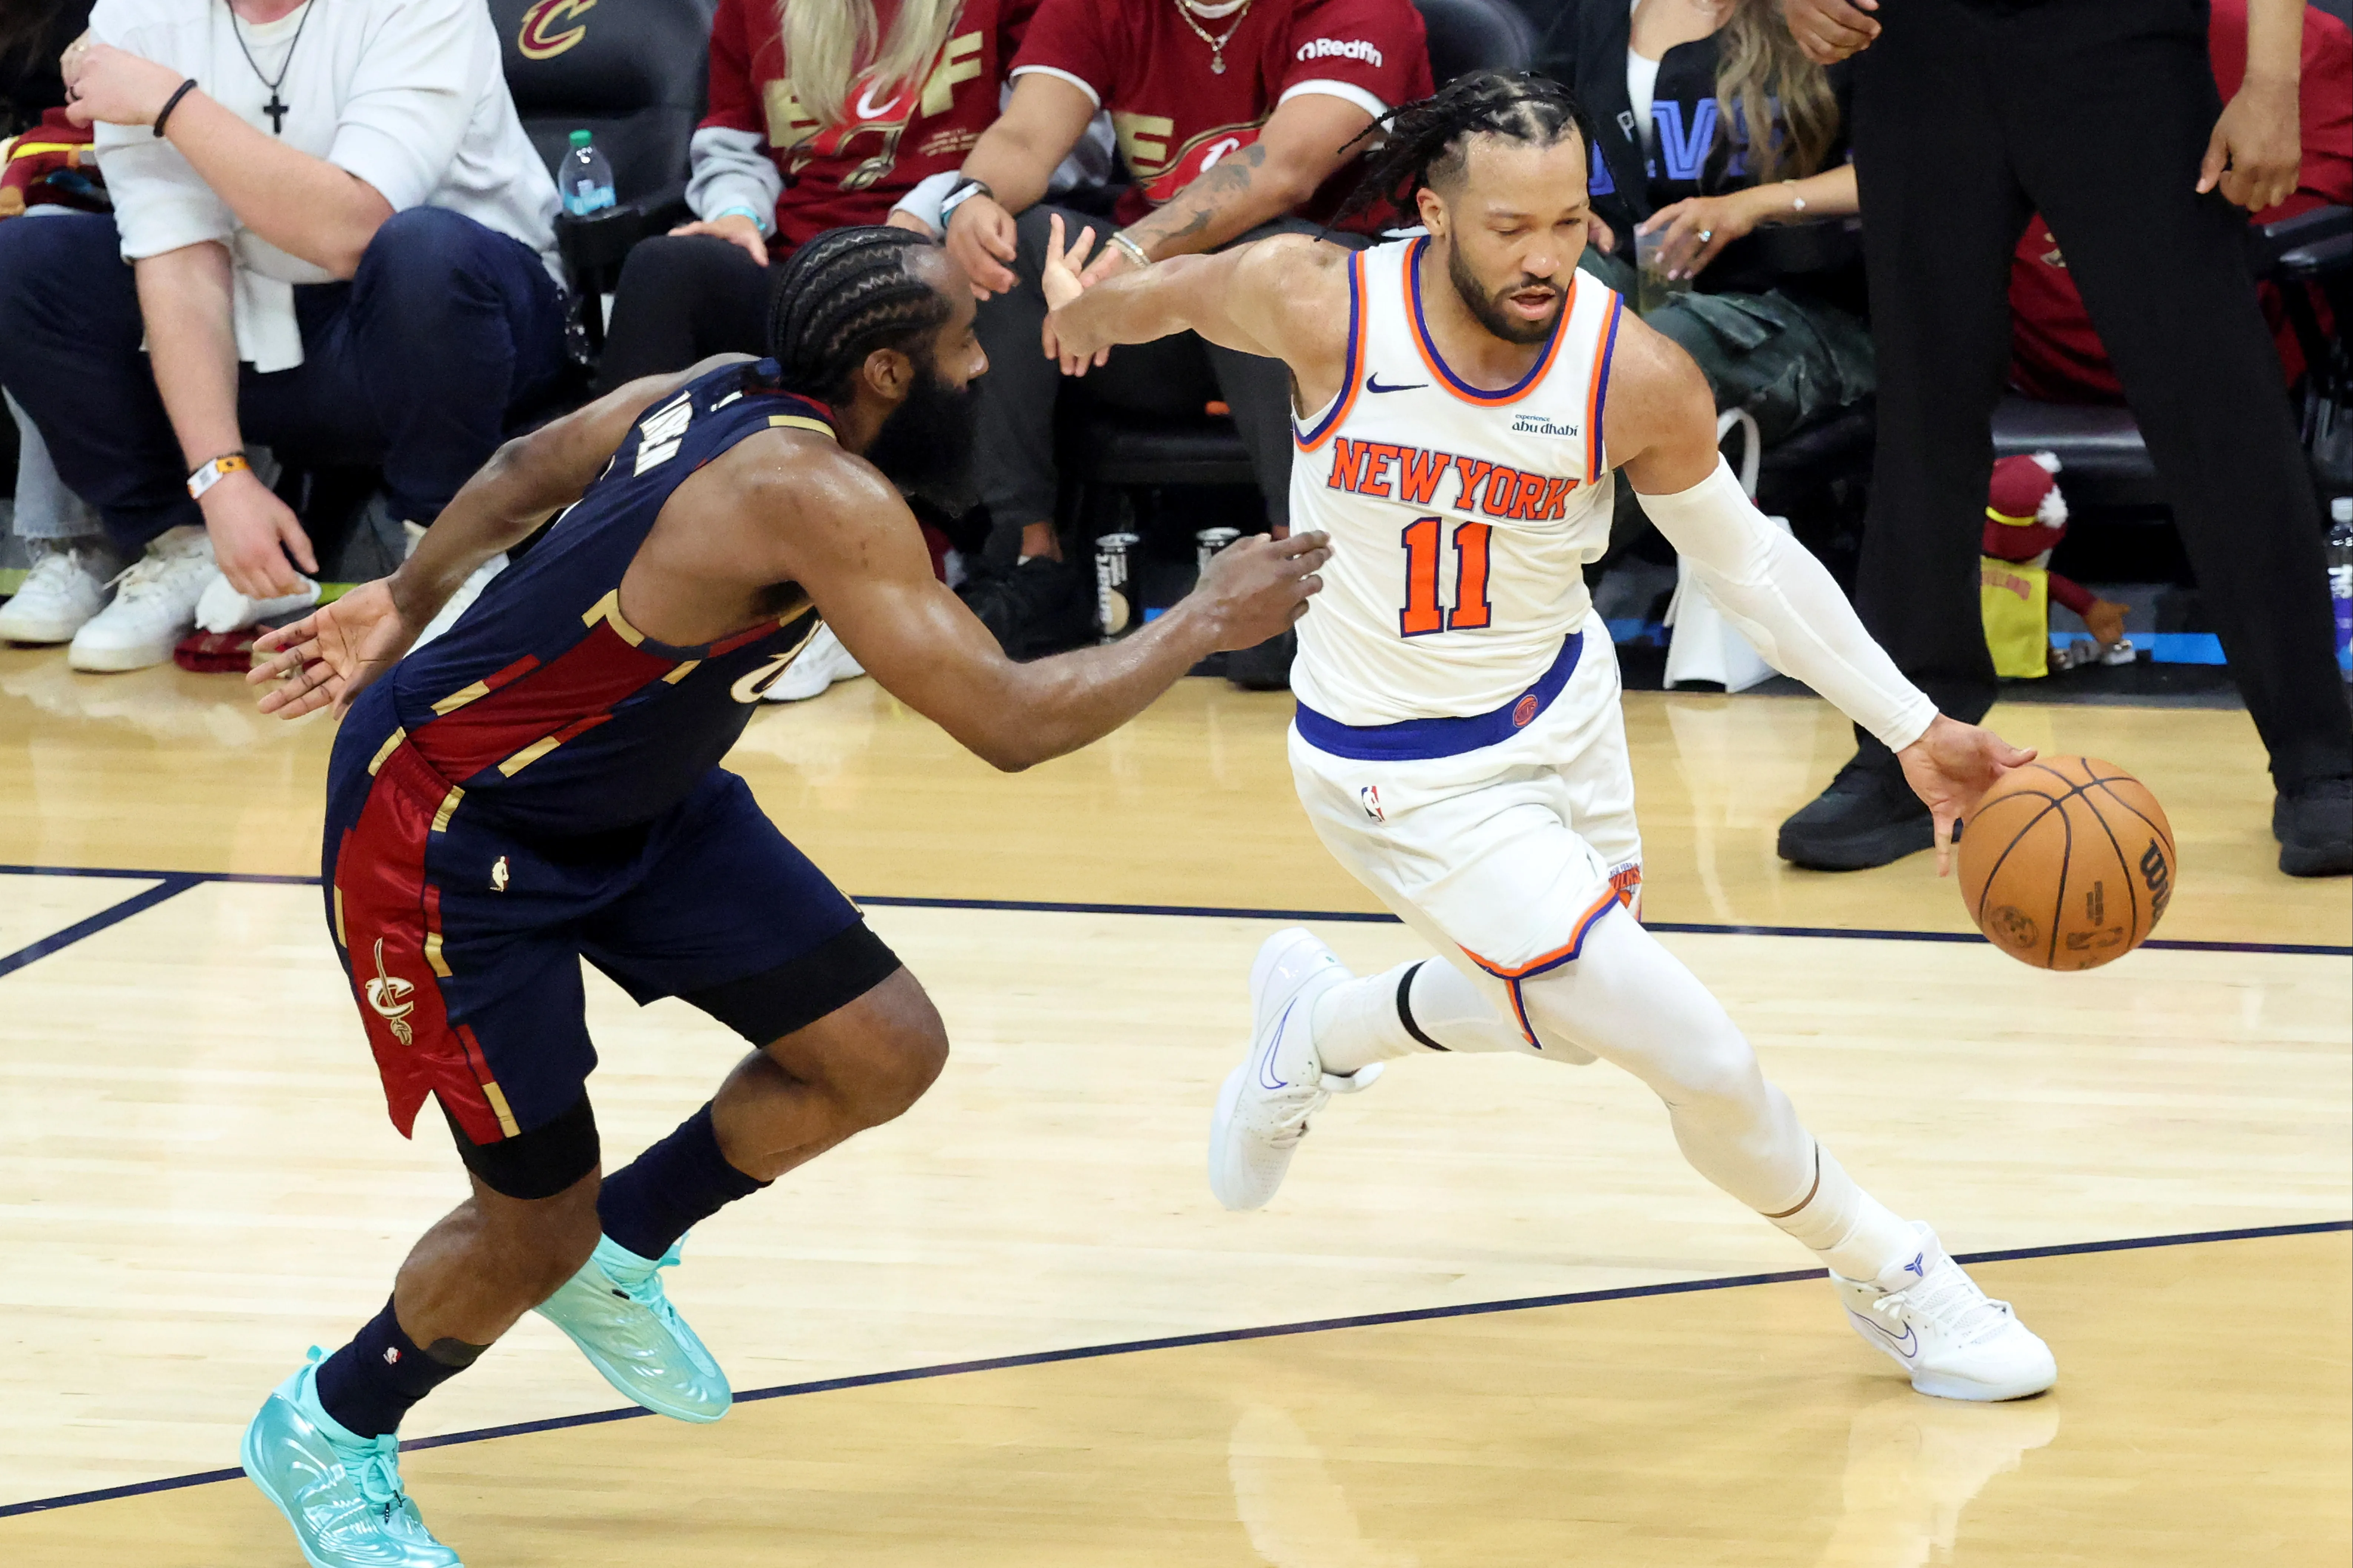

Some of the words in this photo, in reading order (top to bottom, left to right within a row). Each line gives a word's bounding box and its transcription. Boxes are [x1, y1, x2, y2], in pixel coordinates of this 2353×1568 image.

[1316, 38, 1382, 68] Redfin
[1512, 420, 1538, 433] abu
[1540, 423, 1579, 436] dhabi
[1515, 414, 1551, 422] experience
[1328, 438, 1450, 505] NEW
[1454, 455, 1580, 520] YORK
[1399, 517, 1493, 638] 11
